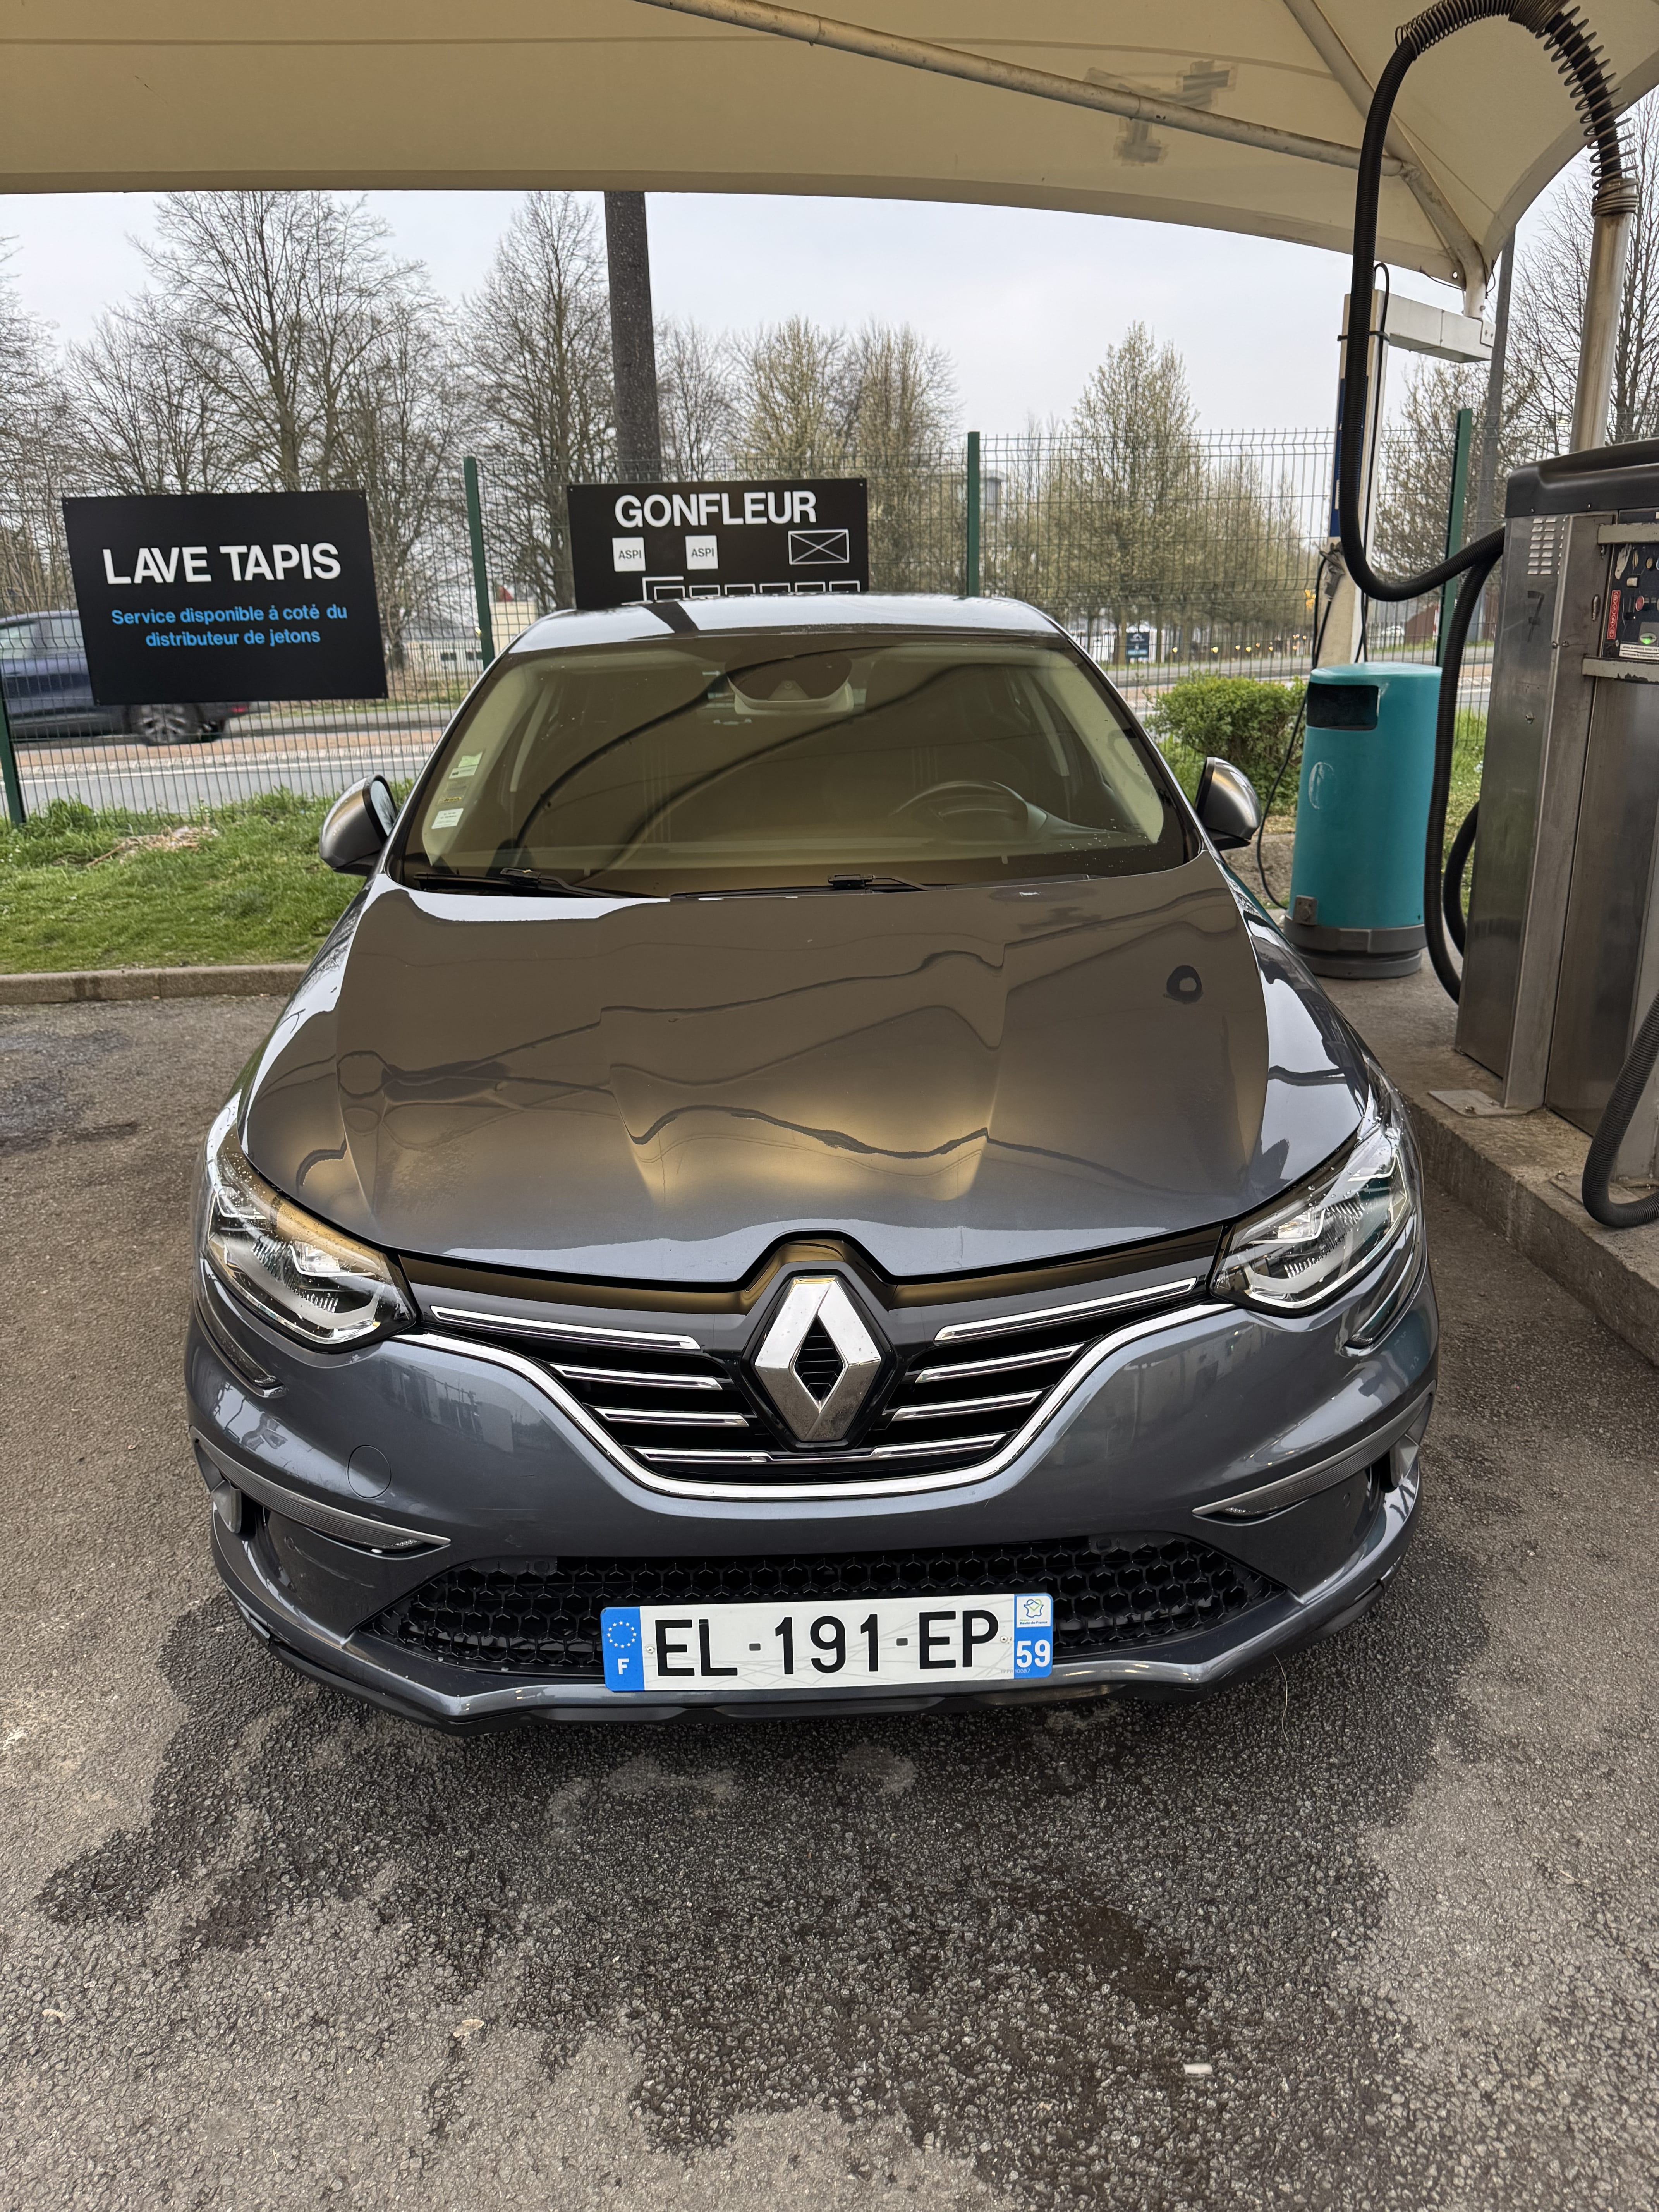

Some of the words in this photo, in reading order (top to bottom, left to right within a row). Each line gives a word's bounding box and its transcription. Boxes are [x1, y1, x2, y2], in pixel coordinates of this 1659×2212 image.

[615, 491, 816, 528] GONFLEUR
[618, 549, 642, 559] ASPI
[691, 548, 714, 558] ASPI
[103, 546, 211, 584] LAVE
[219, 543, 341, 581] TAPIS
[111, 609, 176, 625] Service
[180, 606, 264, 625] disponible
[326, 604, 347, 619] du
[146, 631, 239, 646] distributeur
[244, 630, 265, 644] de
[270, 629, 321, 647] jetons
[1016, 1639, 1051, 1668] 59
[618, 1658, 629, 1674] F
